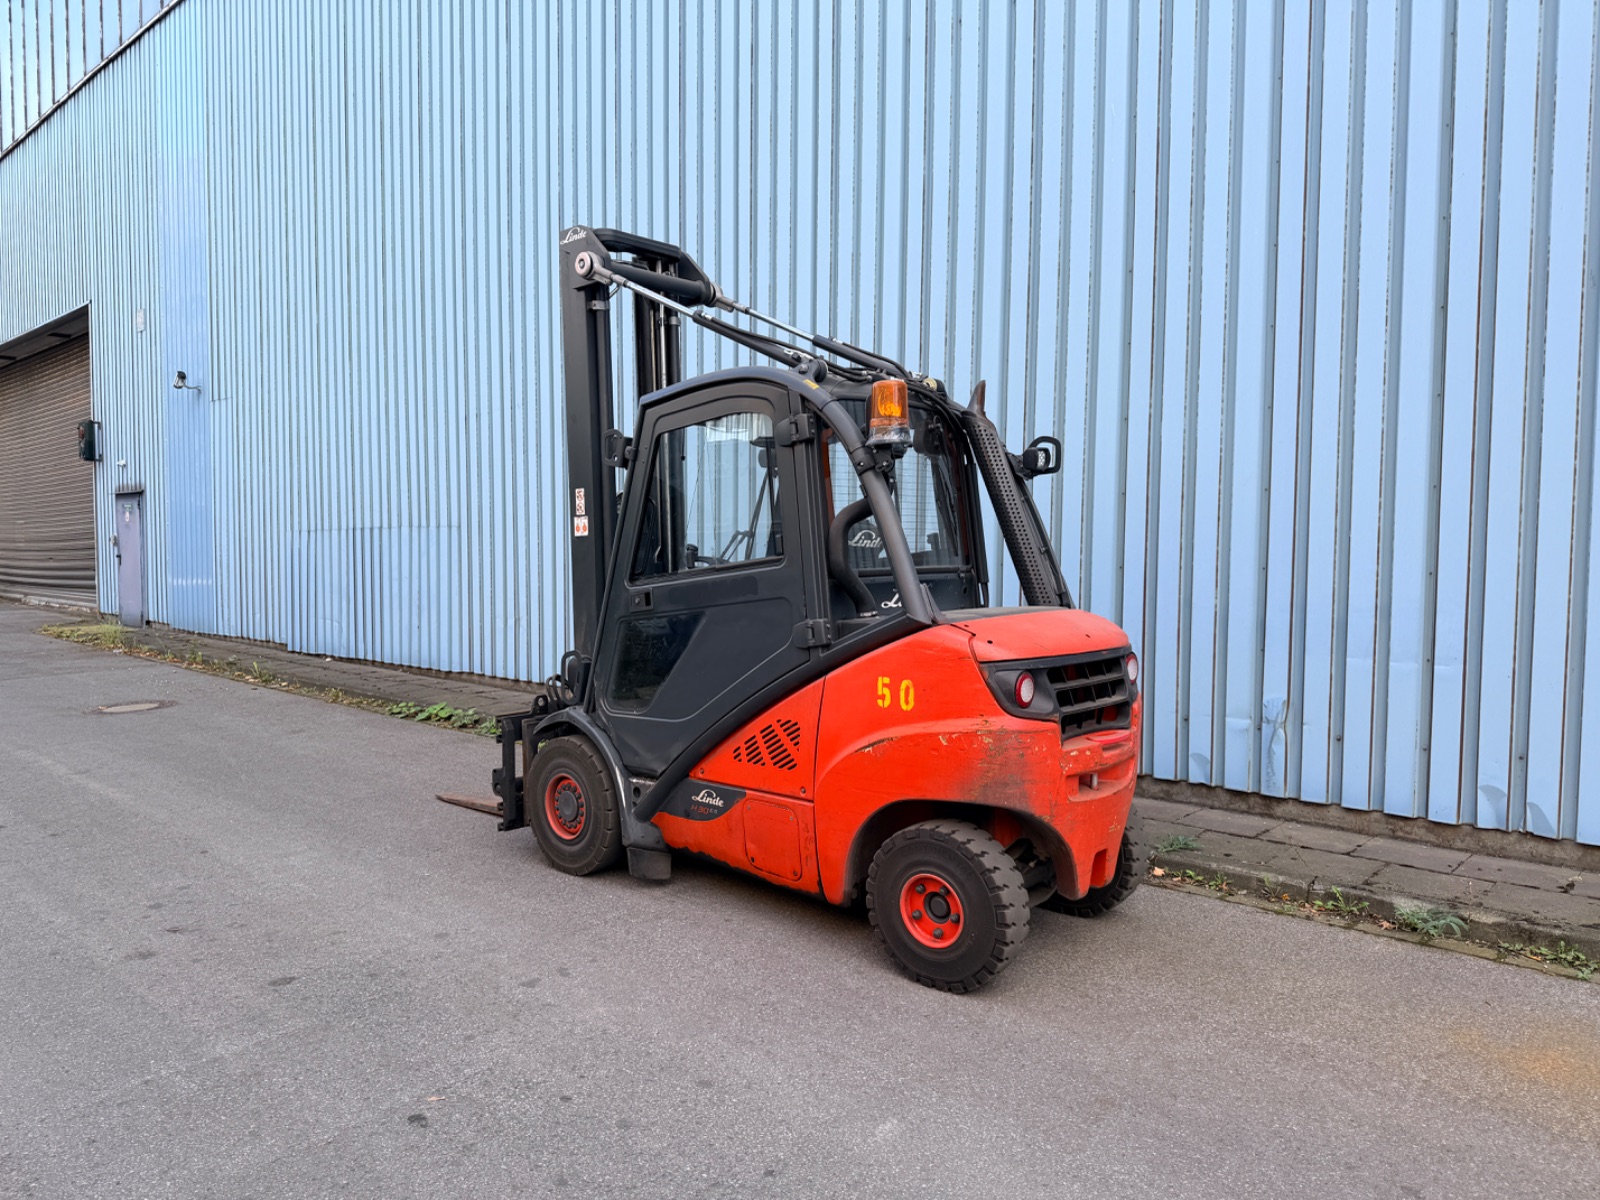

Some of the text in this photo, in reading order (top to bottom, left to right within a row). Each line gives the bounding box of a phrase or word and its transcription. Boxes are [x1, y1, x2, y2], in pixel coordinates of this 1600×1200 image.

[560, 226, 587, 245] Linde
[877, 676, 915, 711] 50
[691, 789, 724, 807] Linde
